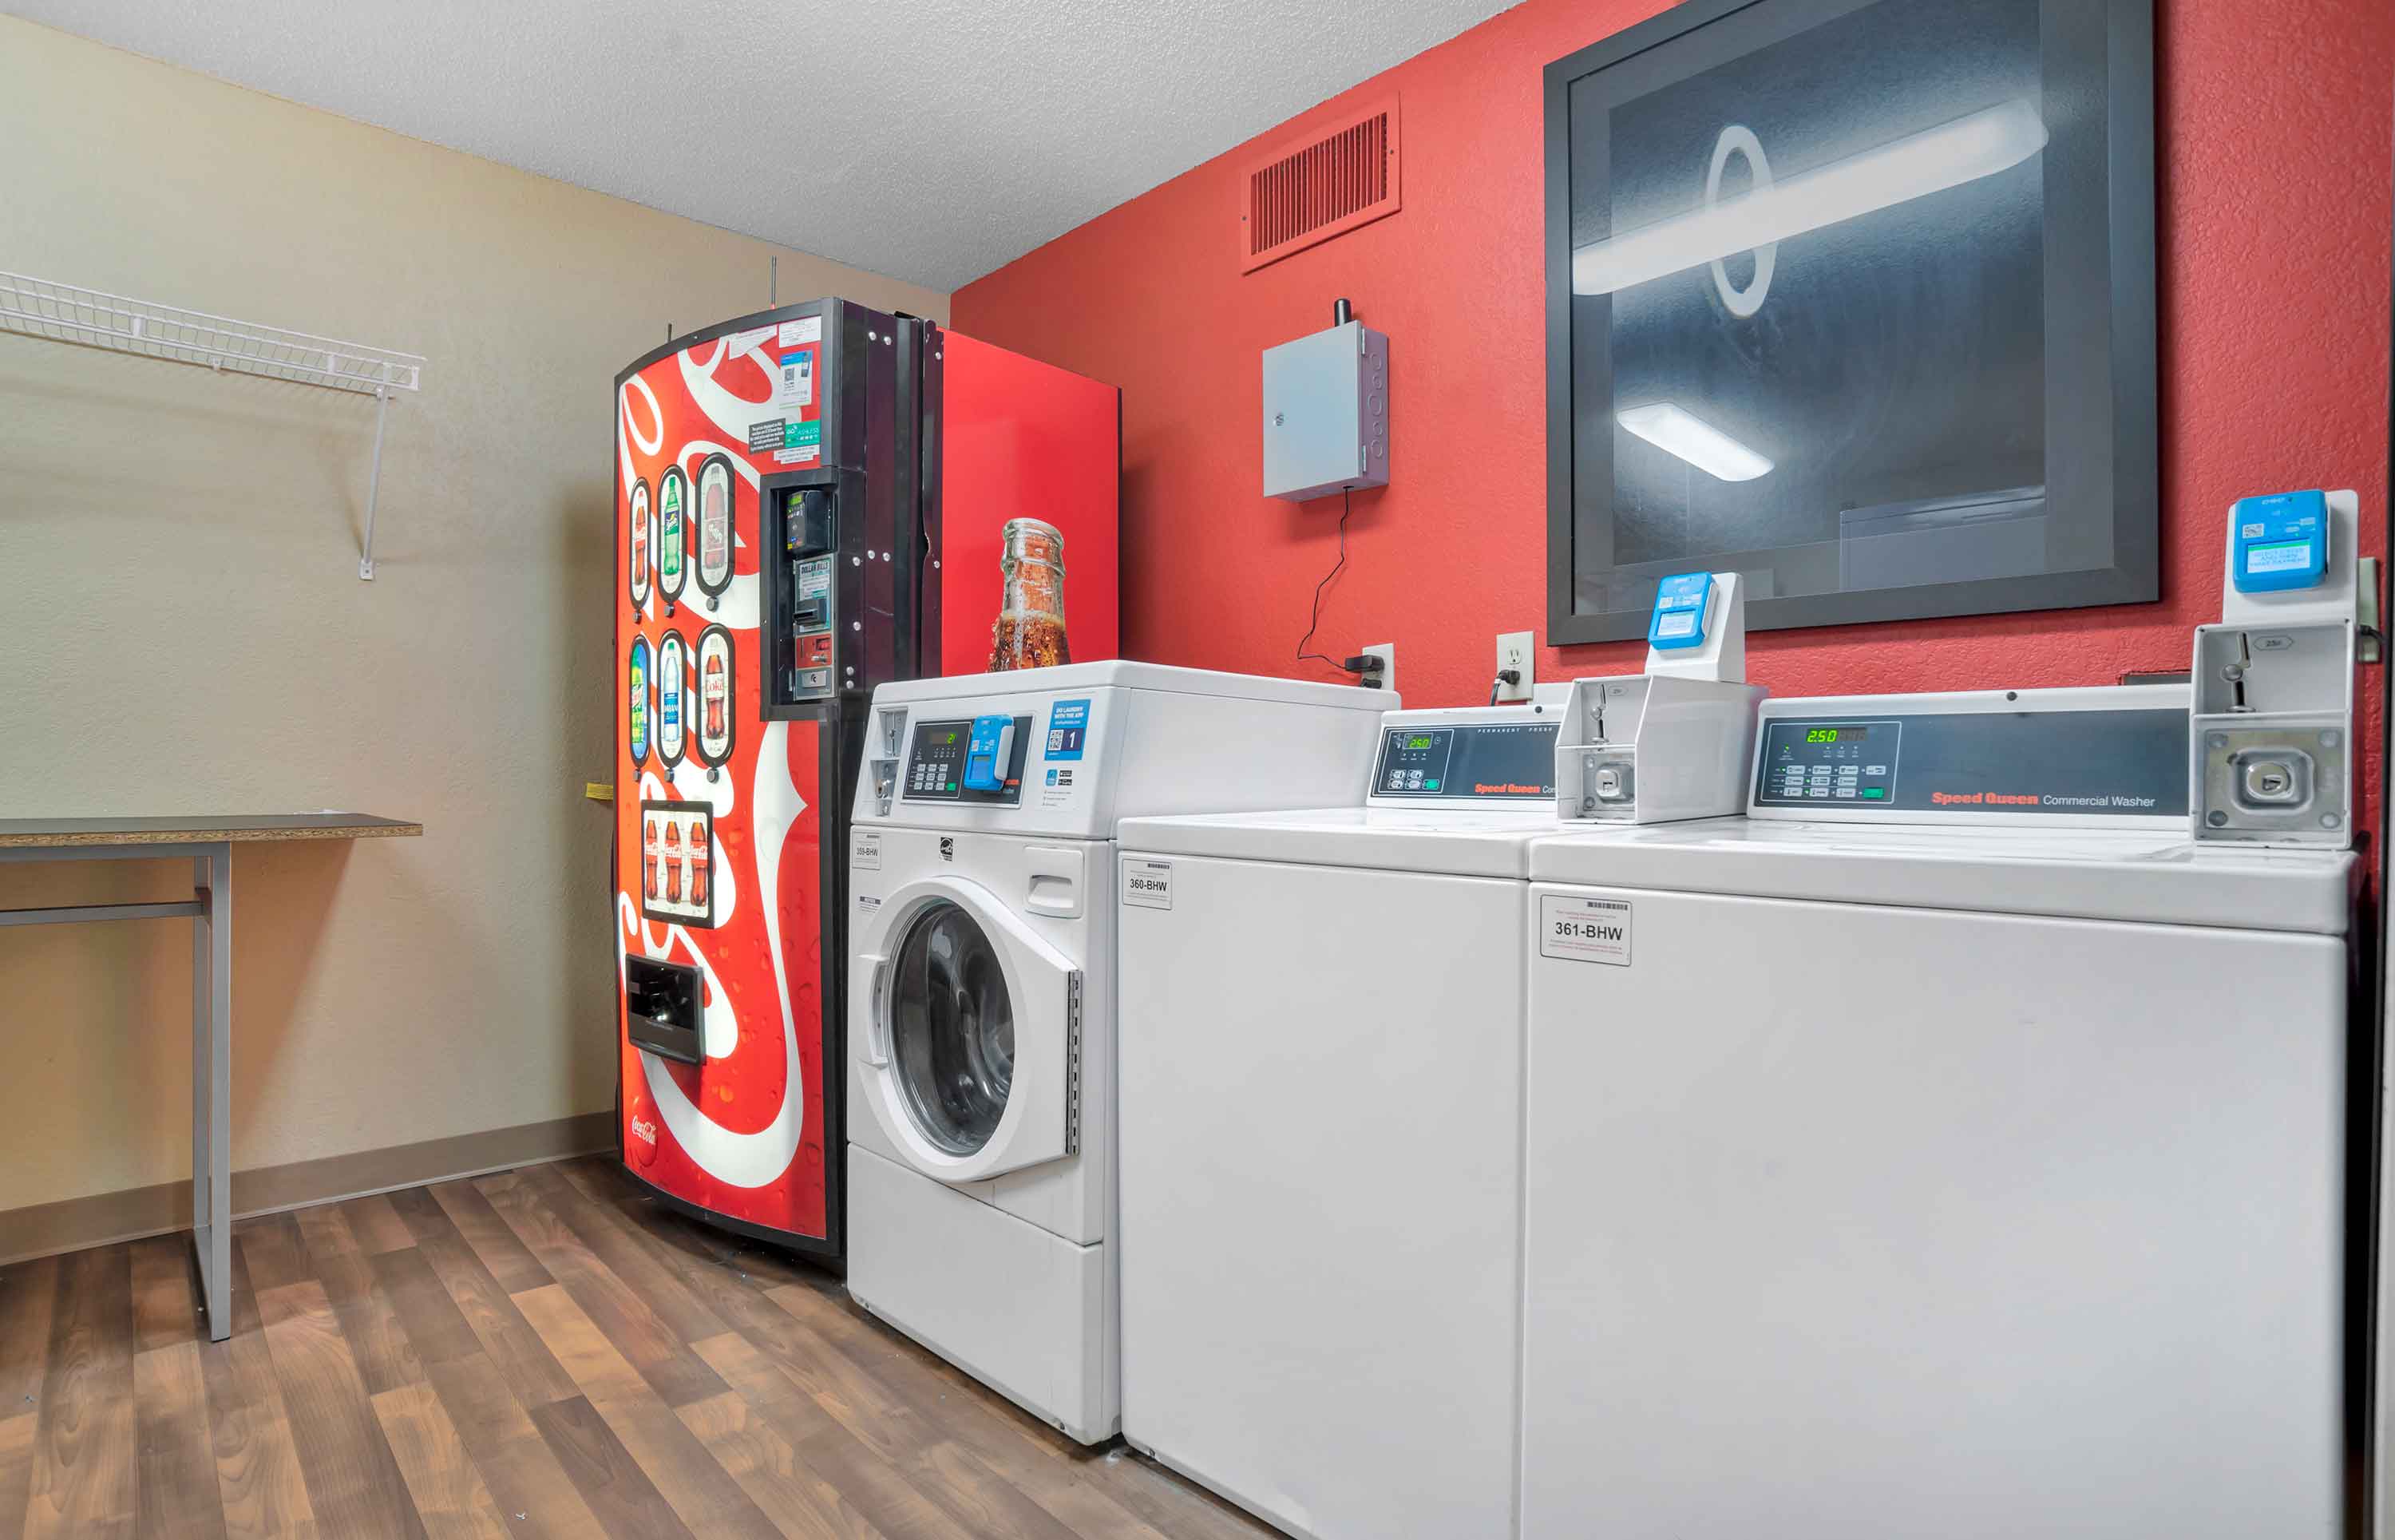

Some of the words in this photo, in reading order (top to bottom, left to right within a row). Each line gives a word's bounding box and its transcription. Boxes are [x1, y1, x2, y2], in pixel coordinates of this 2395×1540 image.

[1069, 731, 1075, 748] 1
[1475, 784, 1507, 794] Speed
[1507, 784, 1541, 794] Queen
[1932, 792, 1982, 805] Speed
[1985, 792, 2039, 805] Queen
[2043, 795, 2109, 806] Commercial
[2111, 796, 2156, 807] Washer
[1130, 878, 1167, 891] 360-BHW
[1555, 921, 1623, 940] 361-BHW
